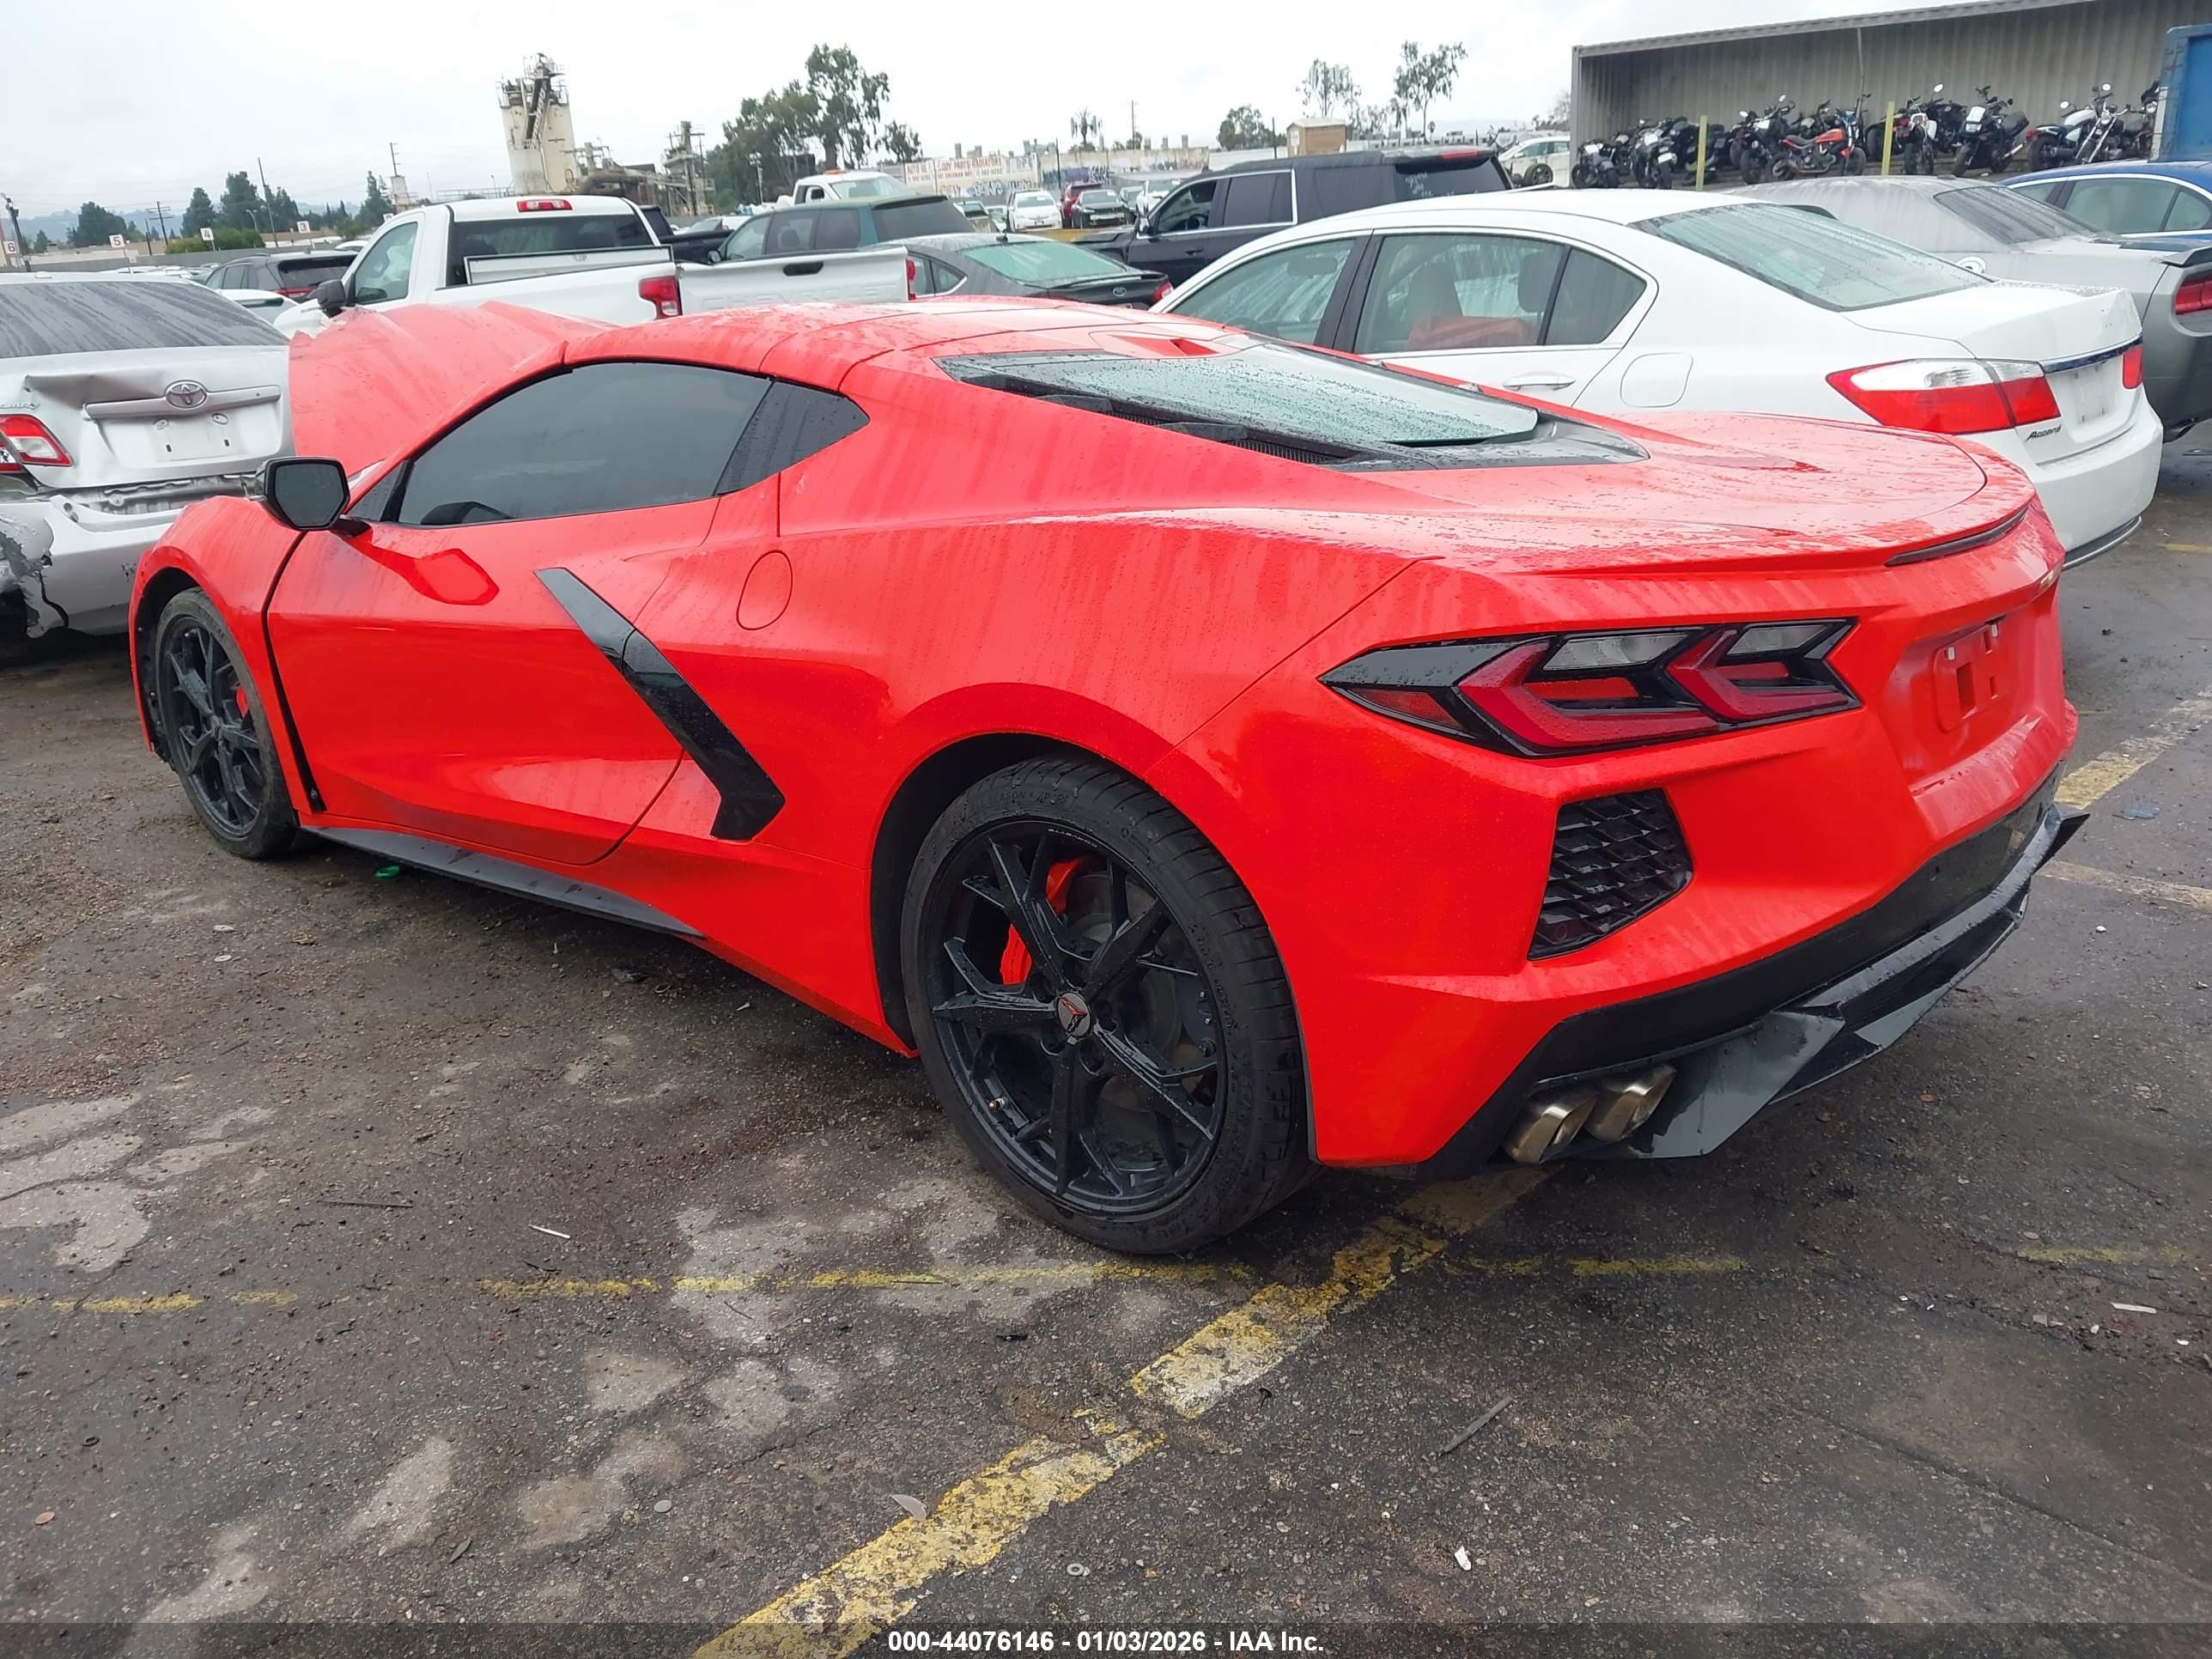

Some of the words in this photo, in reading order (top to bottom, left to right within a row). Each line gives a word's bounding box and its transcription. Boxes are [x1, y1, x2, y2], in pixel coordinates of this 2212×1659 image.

[300, 222, 307, 232] 3
[204, 228, 211, 240] 4
[113, 236, 122, 246] 5
[7, 242, 15, 252] 6
